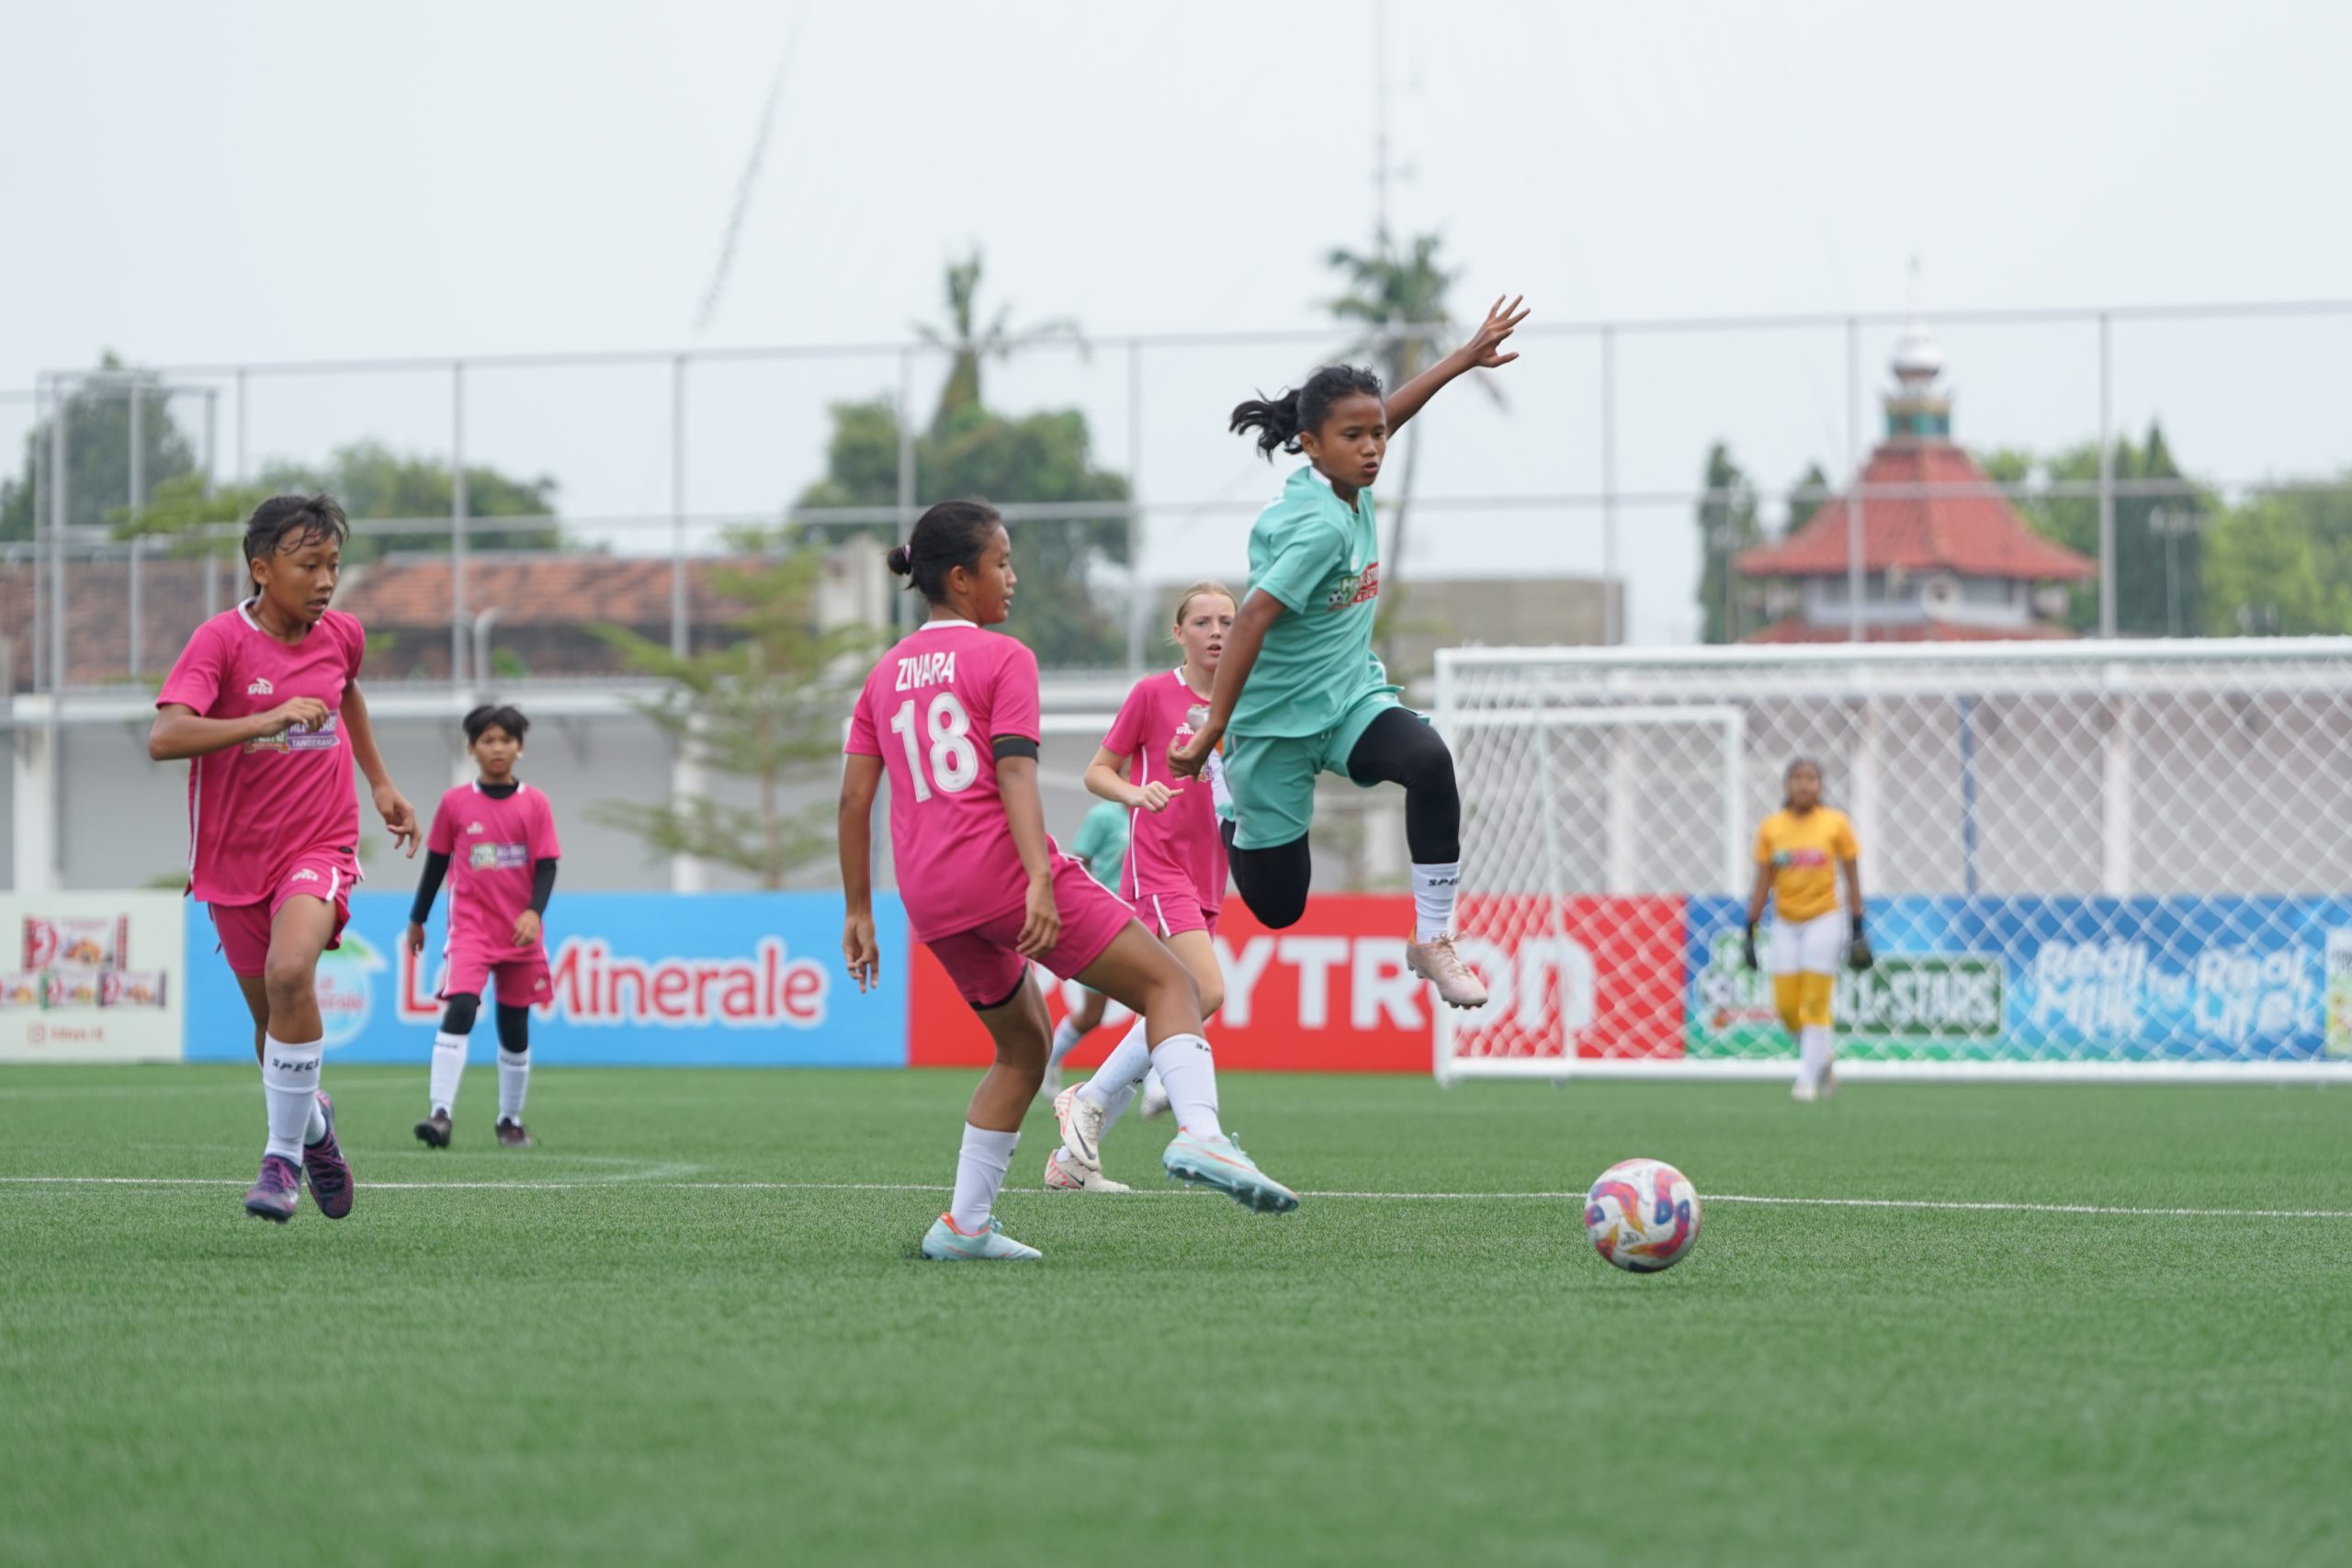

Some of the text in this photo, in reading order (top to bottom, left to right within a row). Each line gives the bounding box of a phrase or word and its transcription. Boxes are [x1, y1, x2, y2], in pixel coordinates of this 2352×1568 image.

[896, 651, 956, 692] ZIVARA
[890, 692, 978, 803] 18
[2033, 941, 2147, 987] Real
[2197, 946, 2306, 991] Real
[2031, 979, 2143, 1039] Milk
[272, 1057, 319, 1072] SPECS
